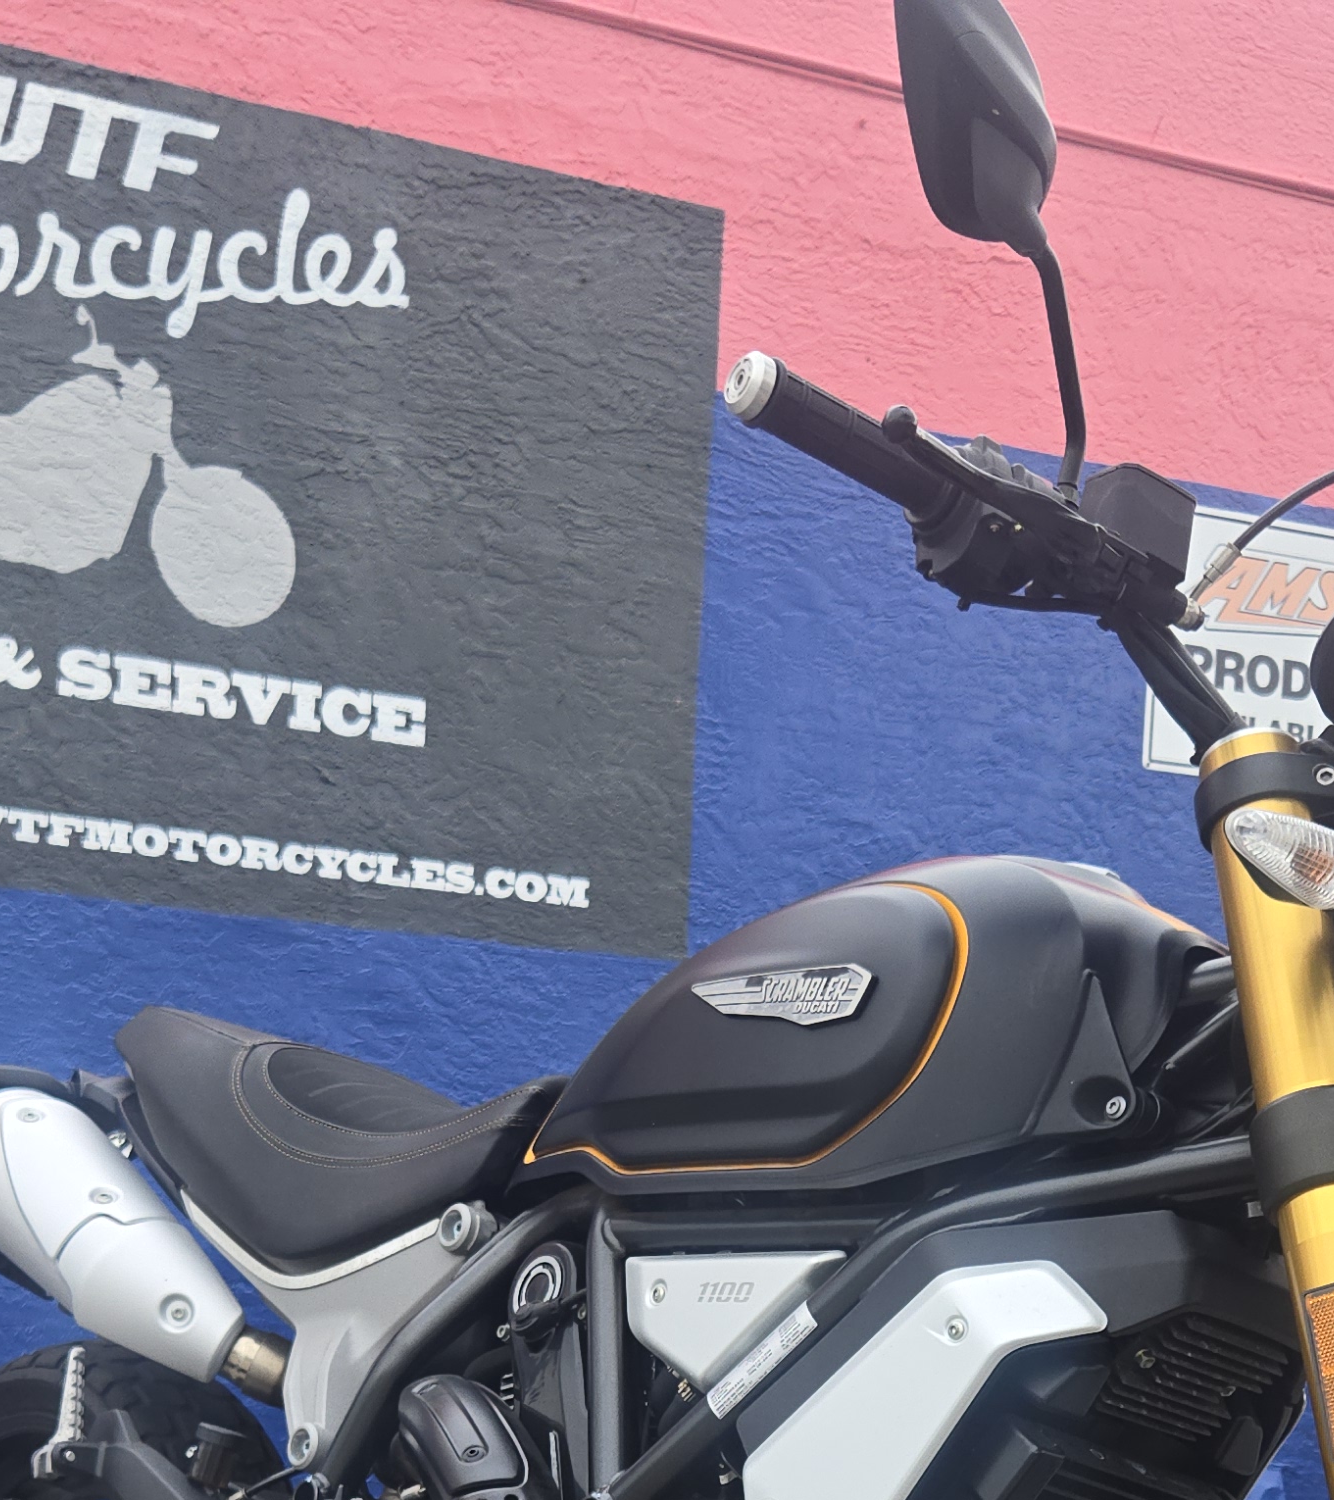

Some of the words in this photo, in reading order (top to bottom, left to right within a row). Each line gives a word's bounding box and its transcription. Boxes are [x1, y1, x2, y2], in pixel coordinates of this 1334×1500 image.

[55, 645, 427, 748] SERVICE
[762, 976, 851, 1003] SCRAMBLER
[792, 1001, 840, 1015] DUCATI
[696, 1281, 755, 1303] 1100
